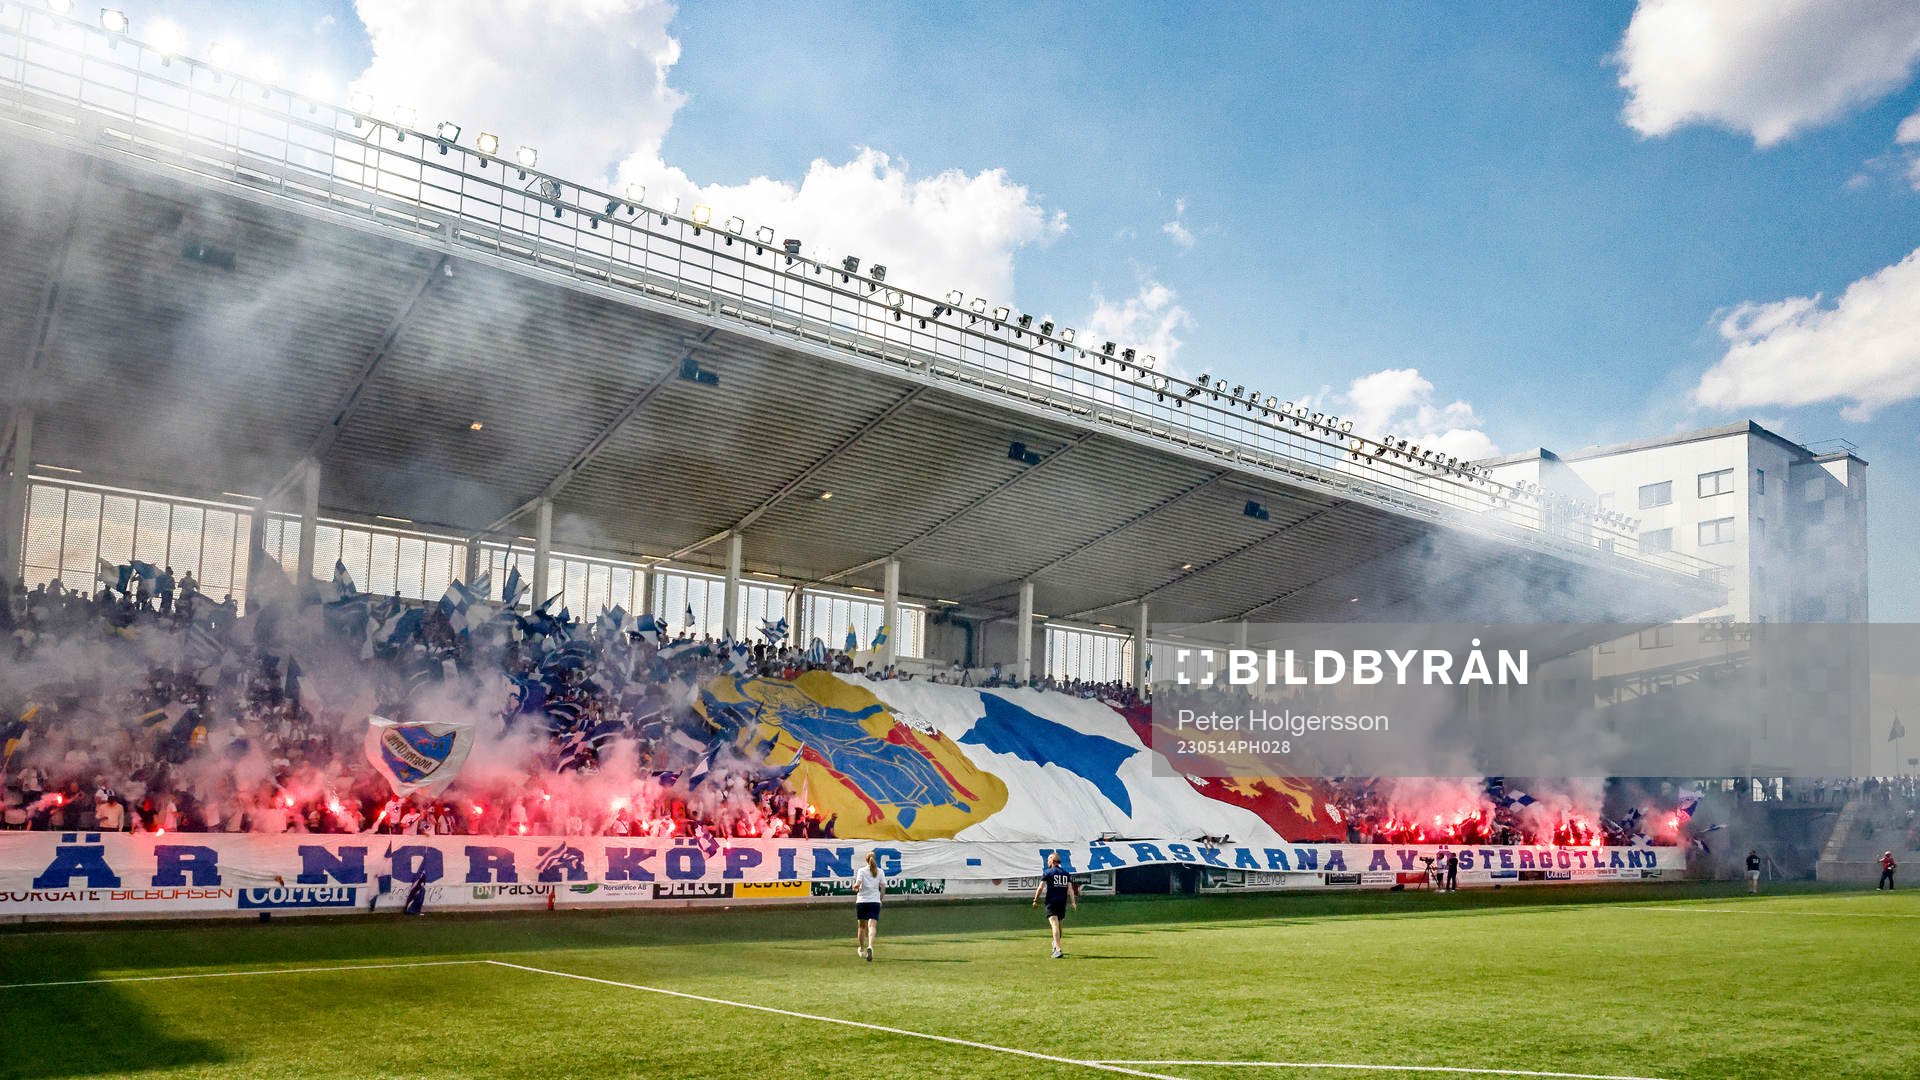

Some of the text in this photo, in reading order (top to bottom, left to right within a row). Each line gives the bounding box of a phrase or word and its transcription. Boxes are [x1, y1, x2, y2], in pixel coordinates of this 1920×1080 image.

[33, 833, 221, 889] ÄR
[297, 838, 902, 884] NORRKÖPING
[1039, 840, 1348, 874] HÄRSKARNA
[1368, 849, 1418, 871] AV
[659, 882, 727, 896] SELECT
